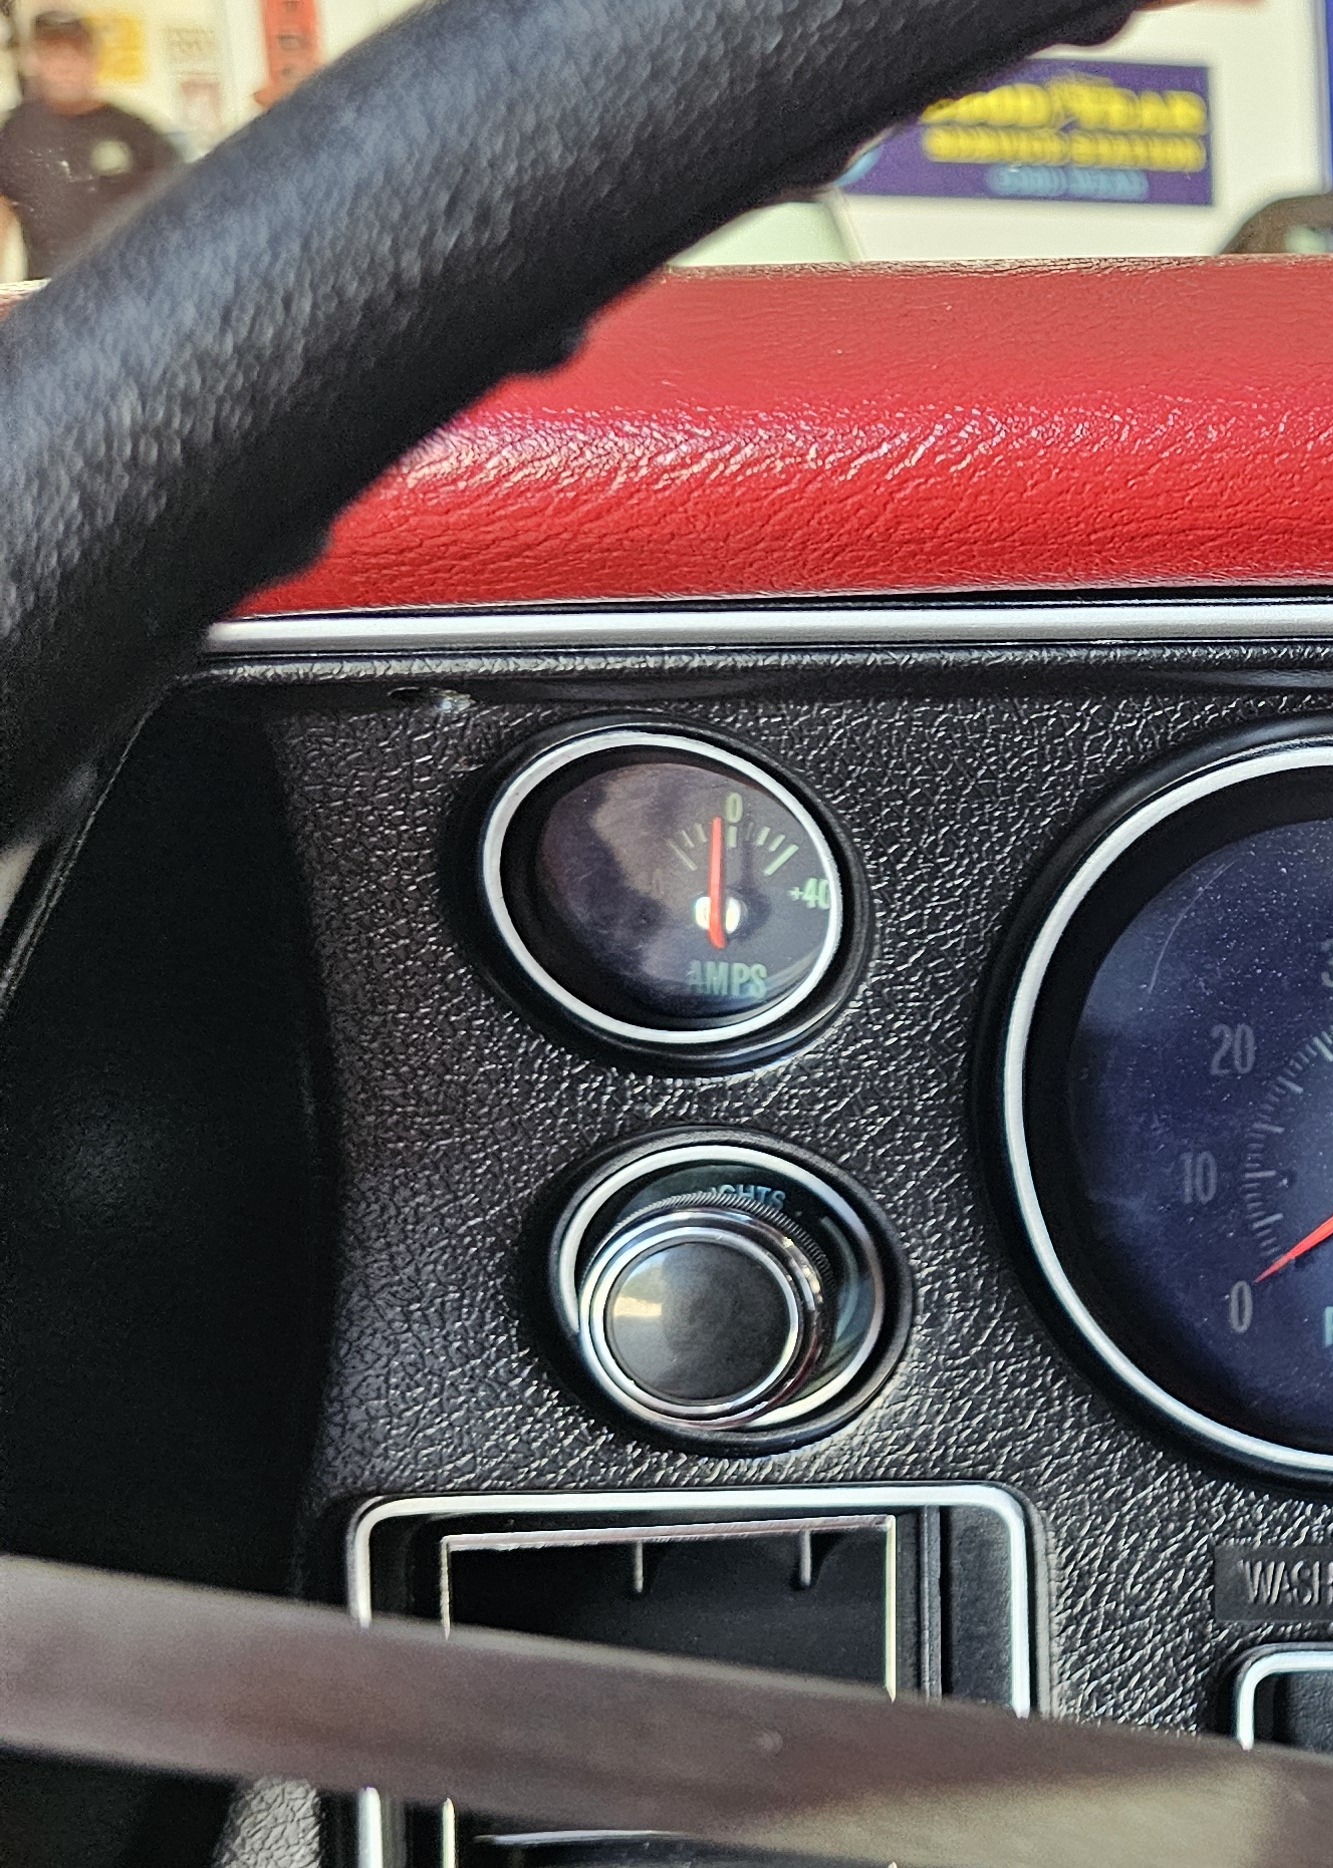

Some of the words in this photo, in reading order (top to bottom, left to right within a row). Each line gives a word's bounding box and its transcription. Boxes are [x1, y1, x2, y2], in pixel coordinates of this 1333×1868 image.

[725, 792, 743, 824] 0
[688, 961, 769, 998] AMPS
[1211, 1024, 1256, 1076] 20
[1183, 1152, 1217, 1203] 10
[1229, 1283, 1253, 1333] 0
